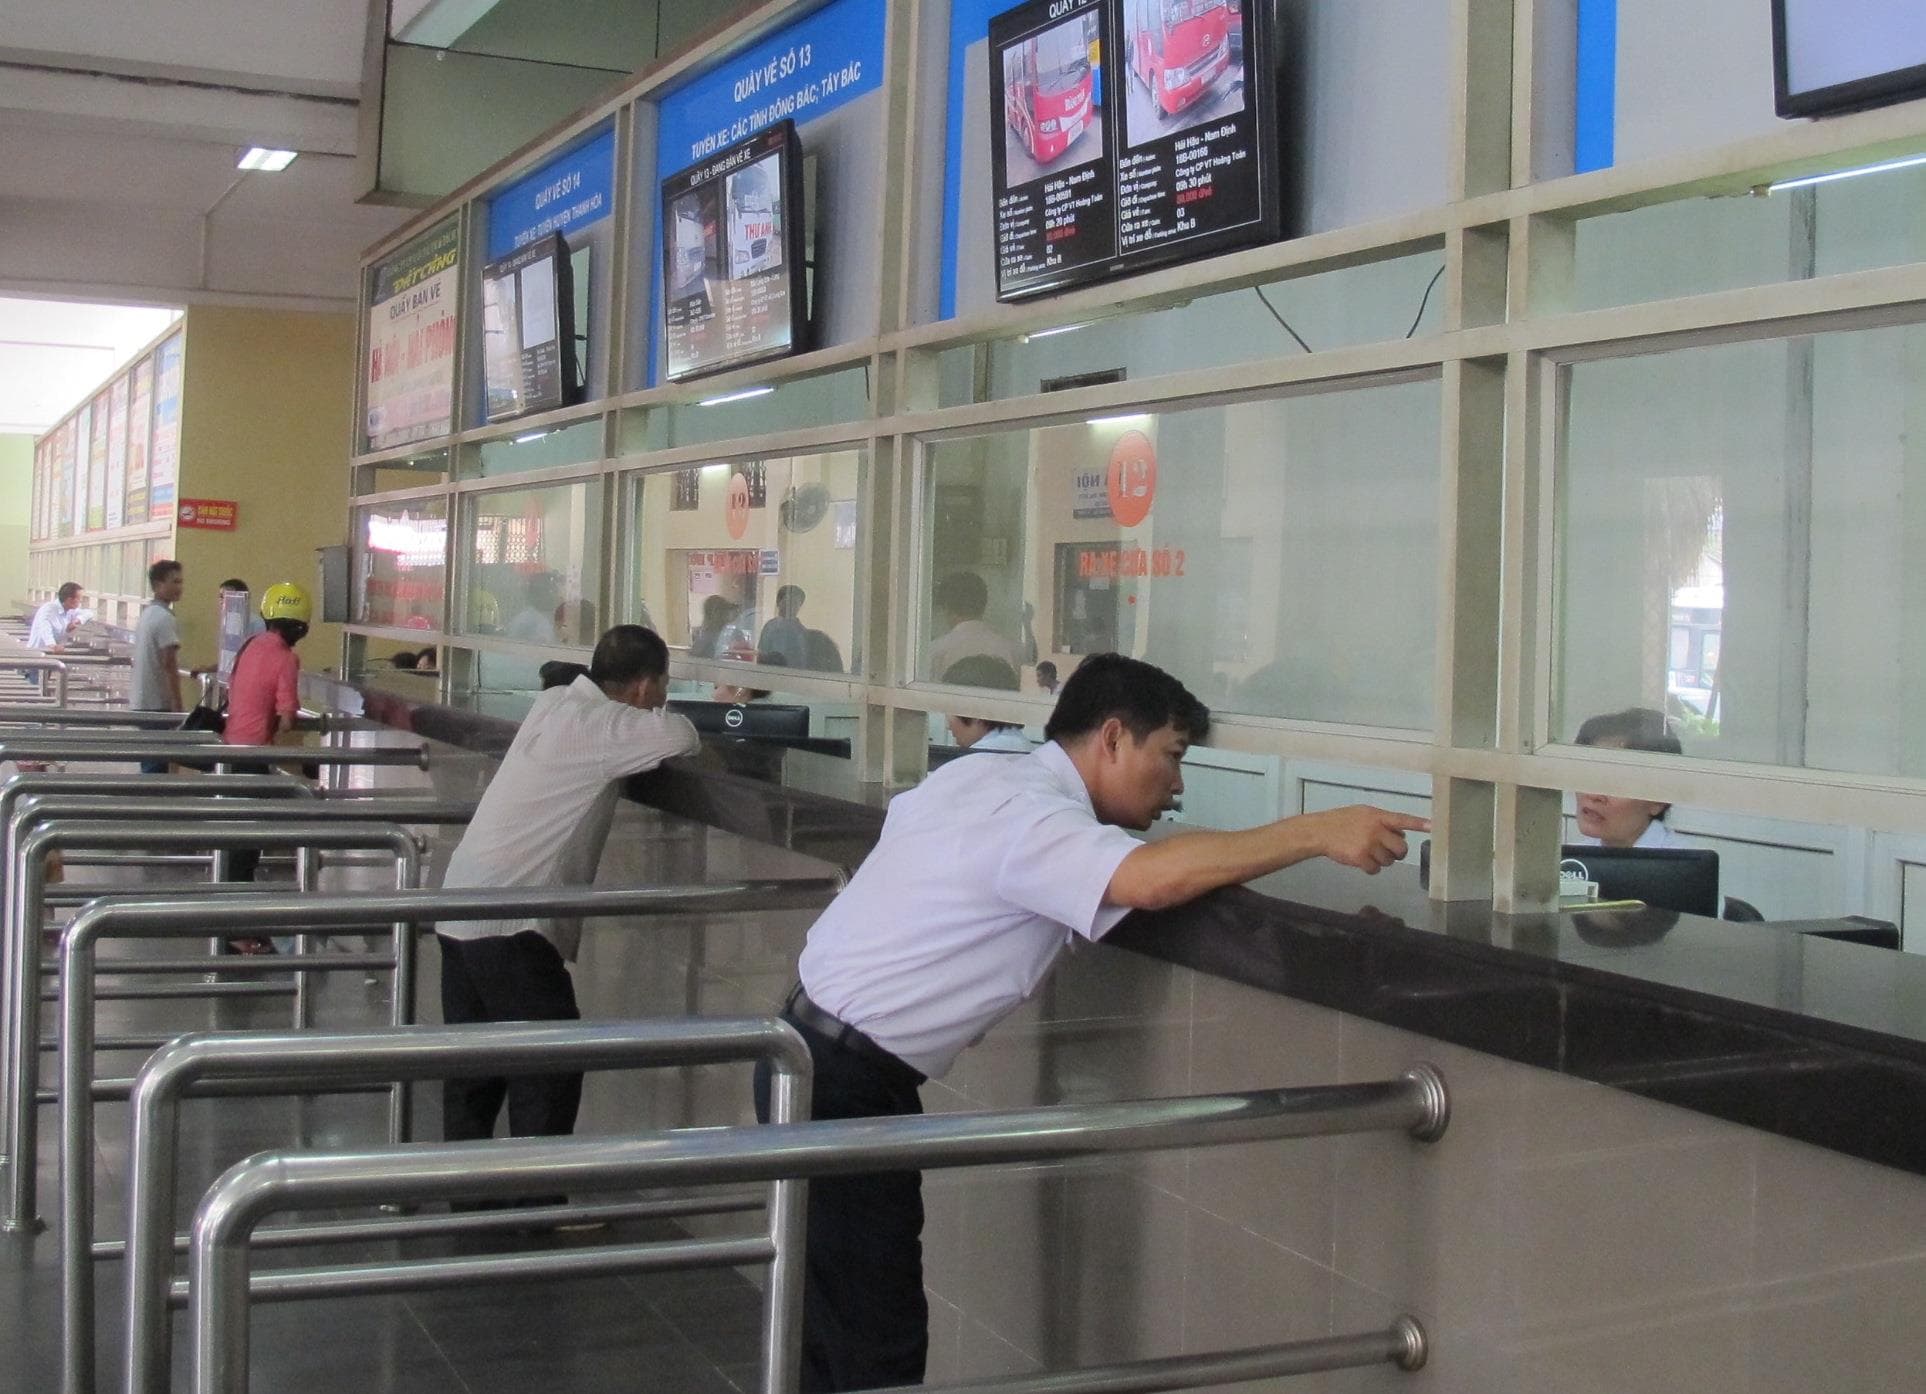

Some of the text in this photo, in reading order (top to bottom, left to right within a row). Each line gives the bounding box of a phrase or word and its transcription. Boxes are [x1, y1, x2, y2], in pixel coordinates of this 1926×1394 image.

[764, 57, 777, 86] VÉ
[779, 48, 796, 78] SỐ
[799, 44, 811, 68] 13
[717, 131, 730, 150] XE:
[731, 116, 748, 141] CÁC
[769, 94, 794, 122] ĐÔNG
[841, 60, 862, 86] BẮC
[1204, 130, 1220, 142] Nam
[1221, 123, 1236, 137] Định
[1195, 161, 1204, 172] CP
[1204, 158, 1212, 169] VT
[1177, 208, 1185, 218] 03
[1177, 221, 1190, 232] Khu
